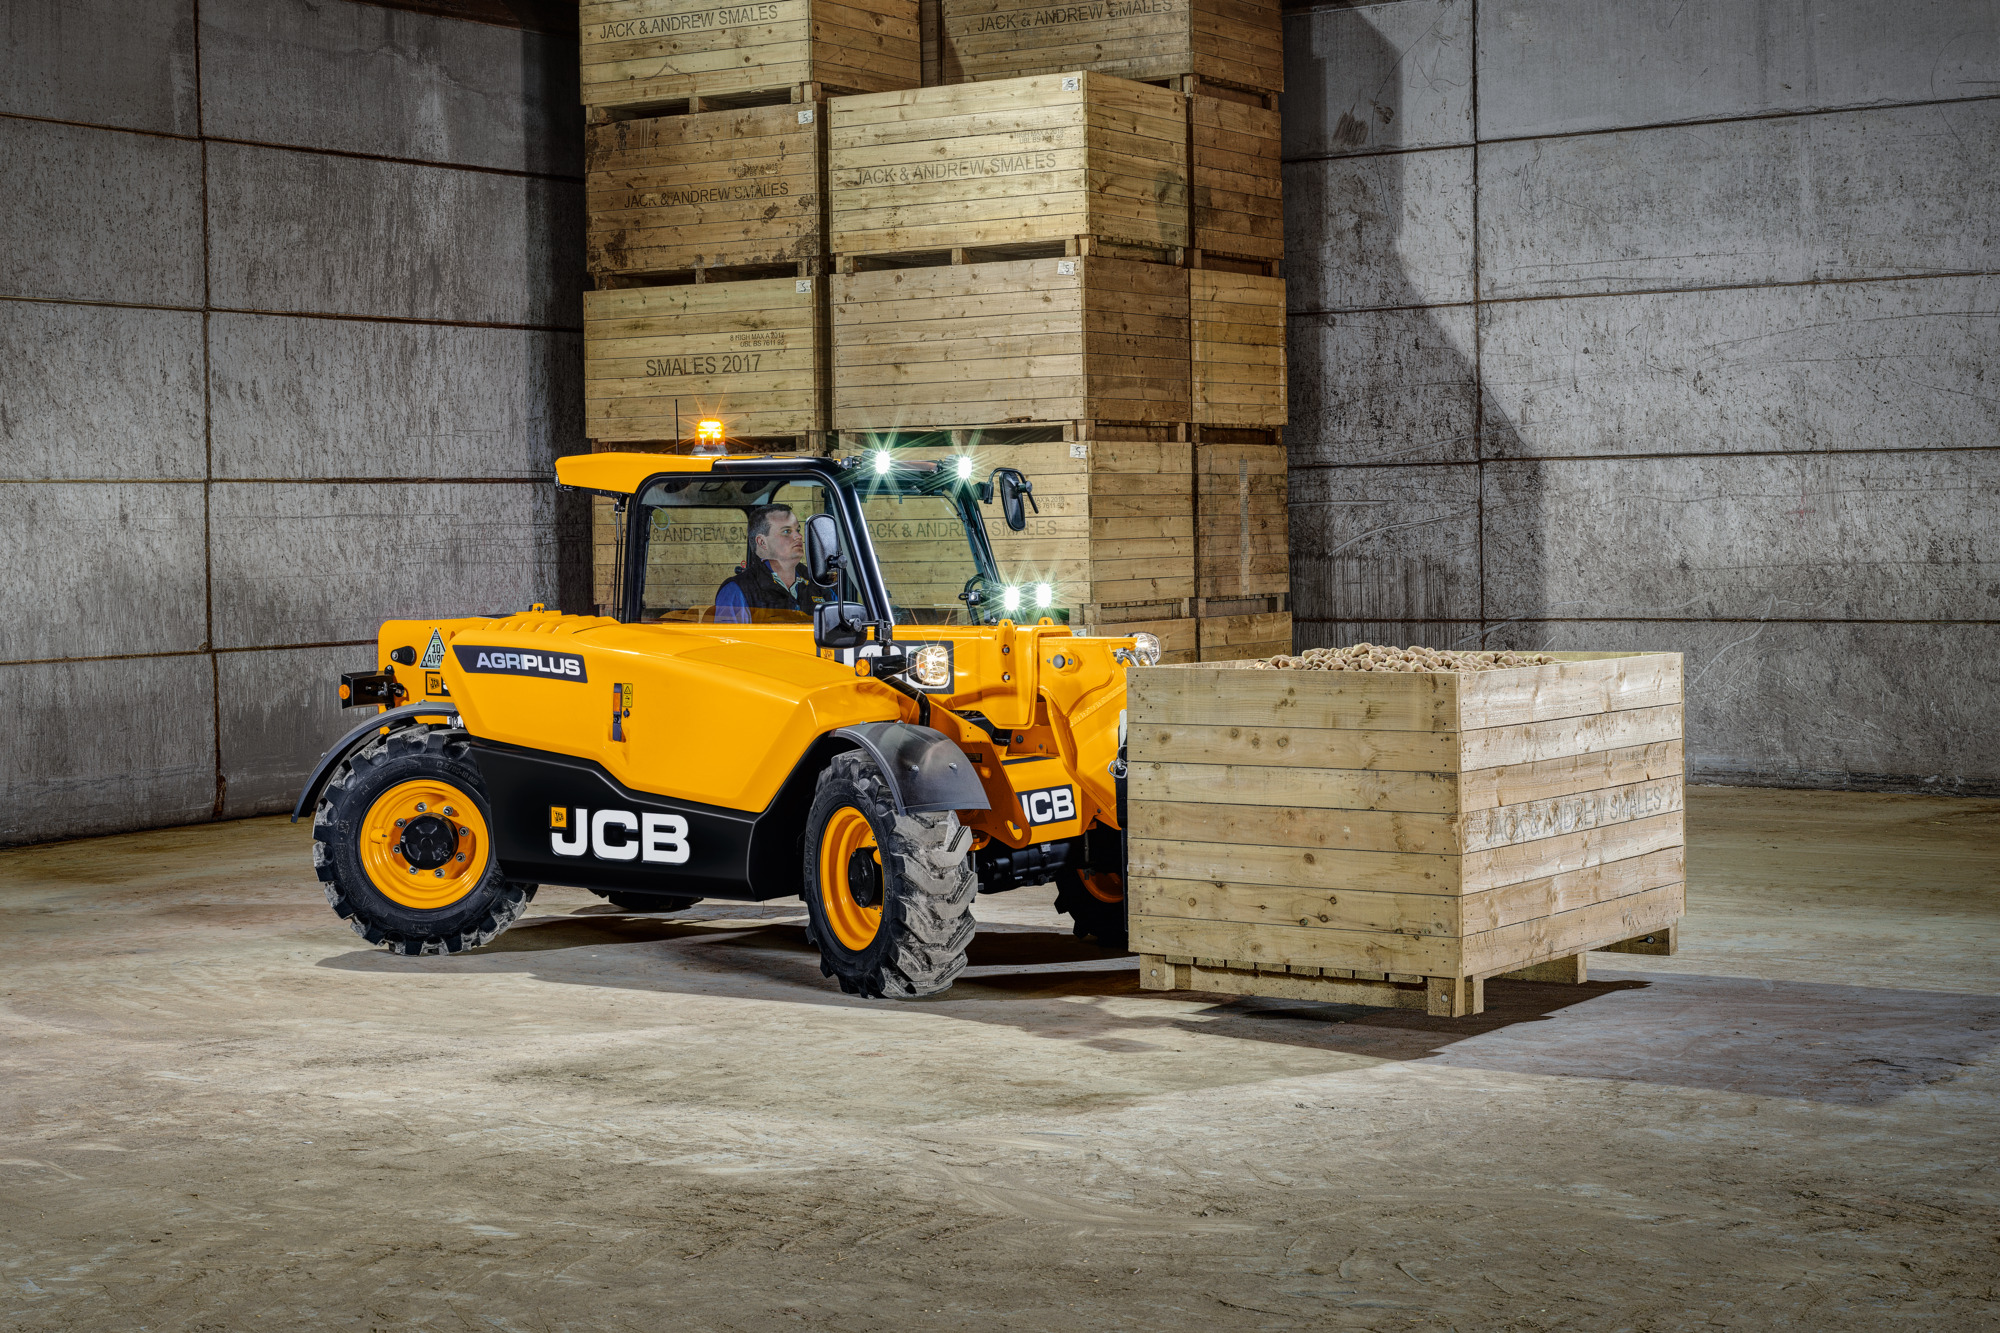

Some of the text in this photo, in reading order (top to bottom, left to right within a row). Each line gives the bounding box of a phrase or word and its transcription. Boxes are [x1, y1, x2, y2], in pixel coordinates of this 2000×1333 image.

[600, 4, 778, 39] JACK & ANDREW SMALES
[978, 14, 1017, 32] JACK
[1034, 4, 1104, 26] ANDREW
[855, 153, 1057, 186] JACK & ANDREW SMALES
[660, 192, 669, 206] &
[672, 187, 731, 205] ANDREW
[734, 181, 789, 199] SMALES
[646, 353, 762, 376] SMALES 2017
[652, 528, 661, 542] &
[663, 526, 723, 542] ANDREW
[868, 523, 897, 538] ACK
[902, 524, 912, 537] &
[1543, 798, 1606, 834] ANDREW
[1610, 786, 1663, 821] SMALES
[551, 808, 691, 865] JCB
